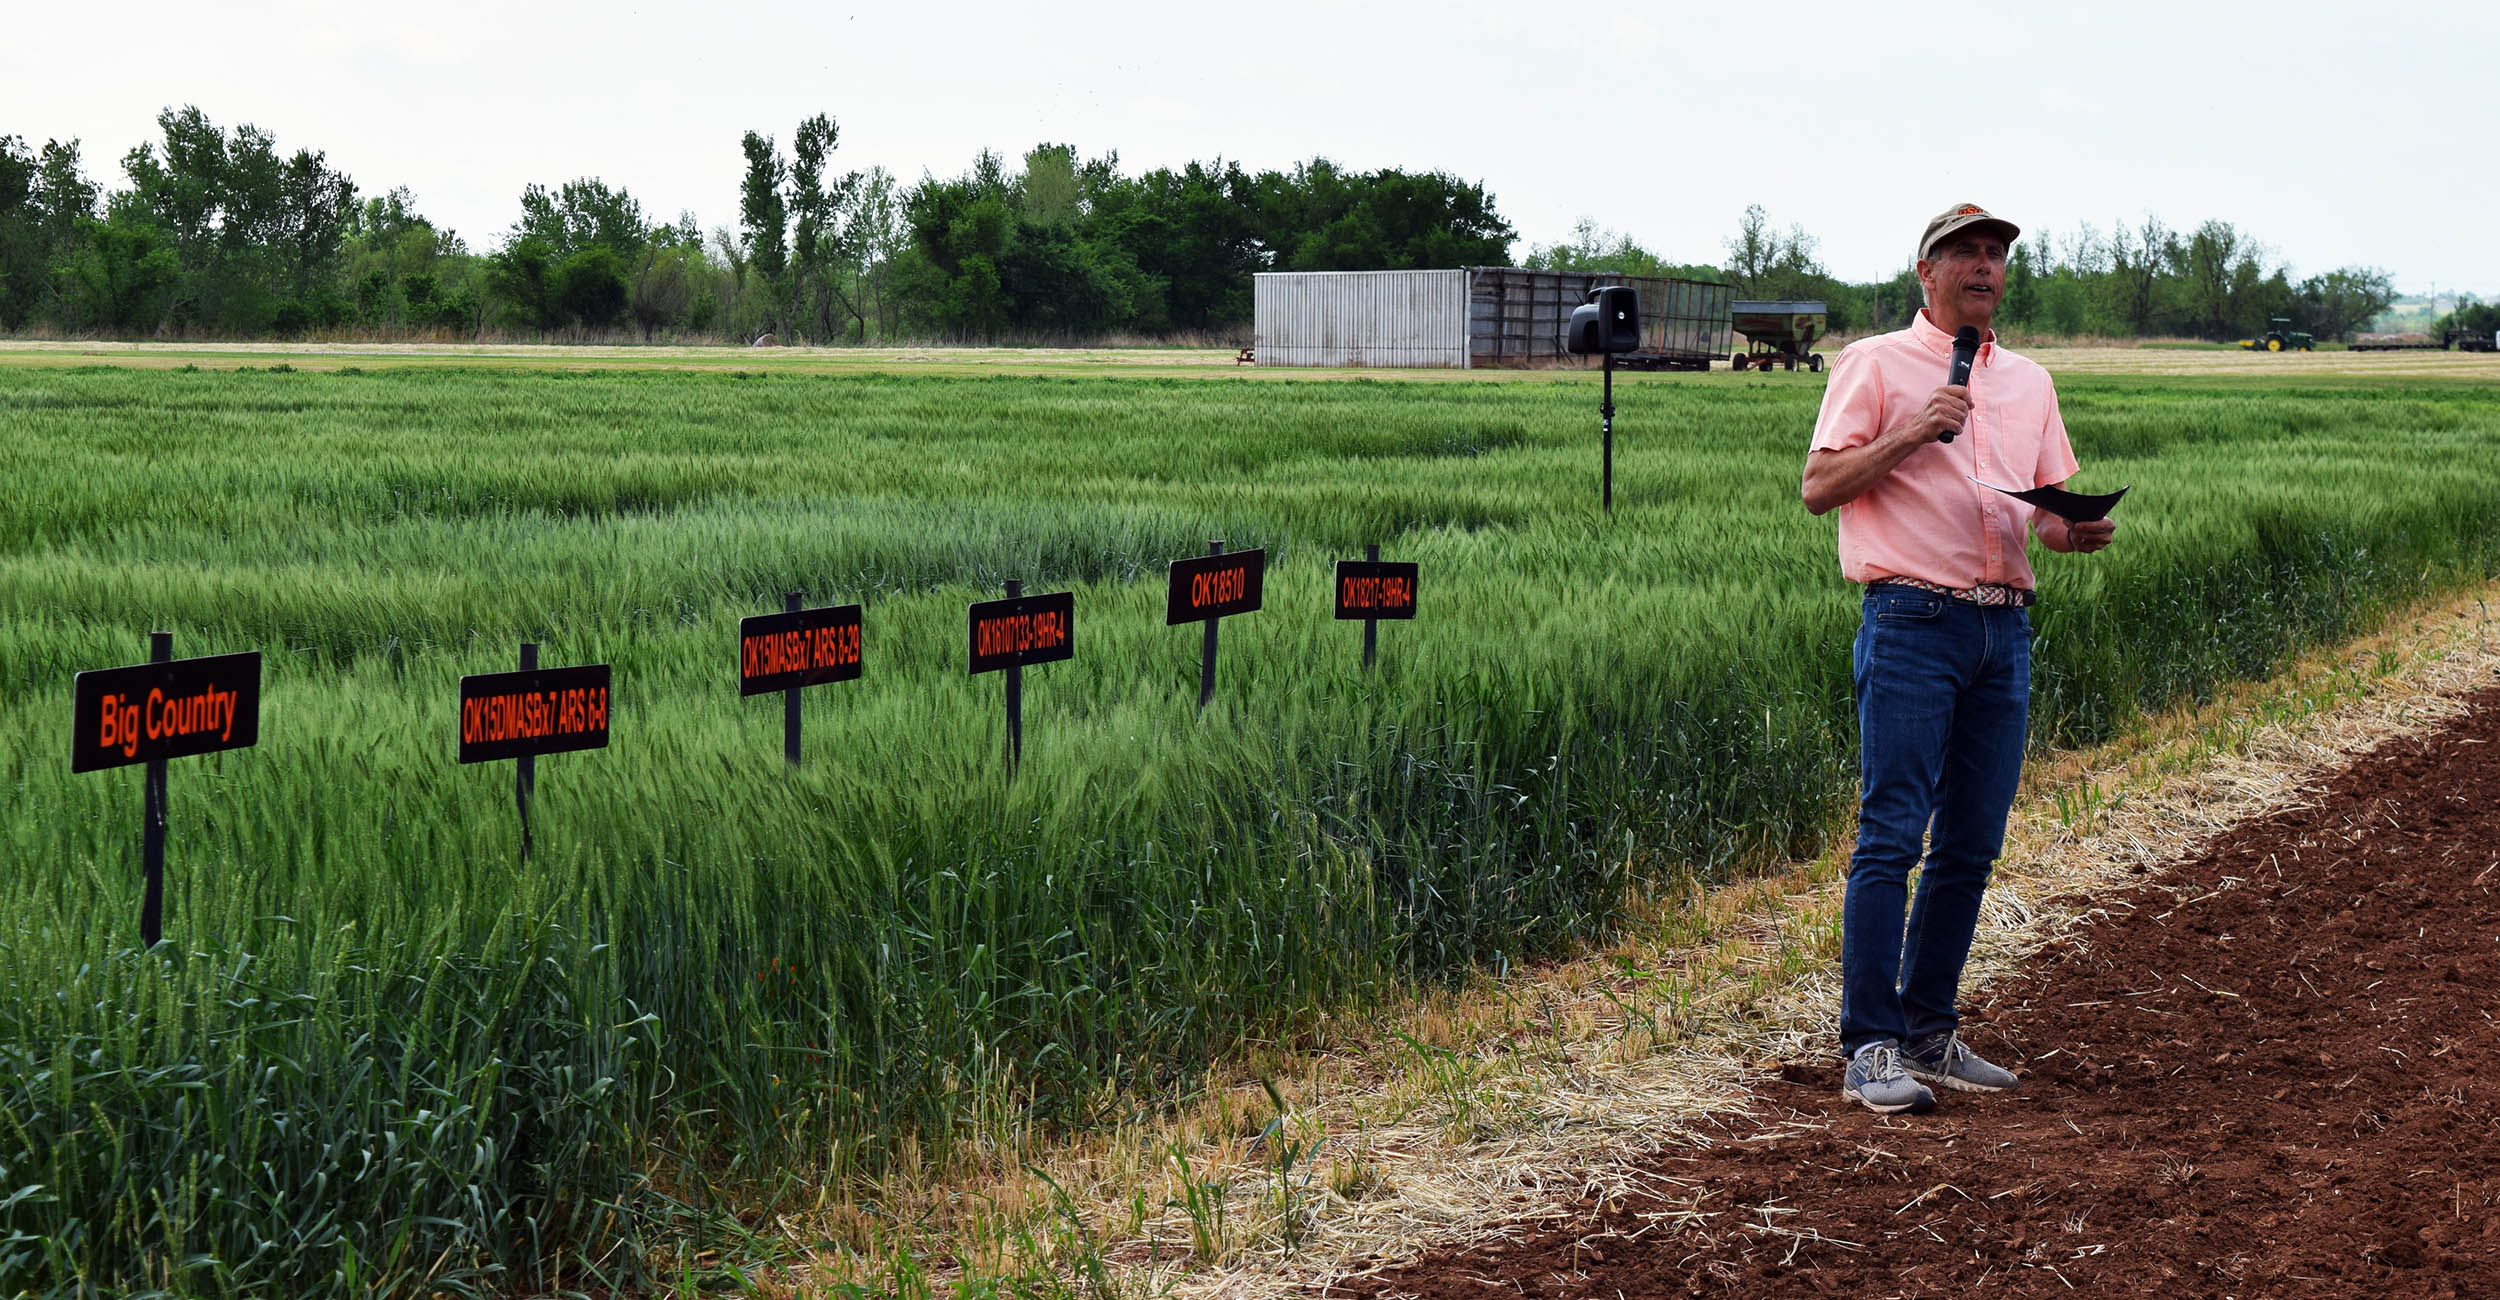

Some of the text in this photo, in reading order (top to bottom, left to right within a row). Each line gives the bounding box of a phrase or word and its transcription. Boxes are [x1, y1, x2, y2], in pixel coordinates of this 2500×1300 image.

[1191, 567, 1245, 608] OK18510
[1343, 576, 1411, 608] OK18217-19HR-4
[743, 623, 860, 679] OK15MASBx7 ARS 8-29
[977, 611, 1065, 657] OK16107133-19HR-4
[99, 683, 239, 759] Big Country
[463, 686, 607, 745] OK15DMASBx7 ARS 6-8
